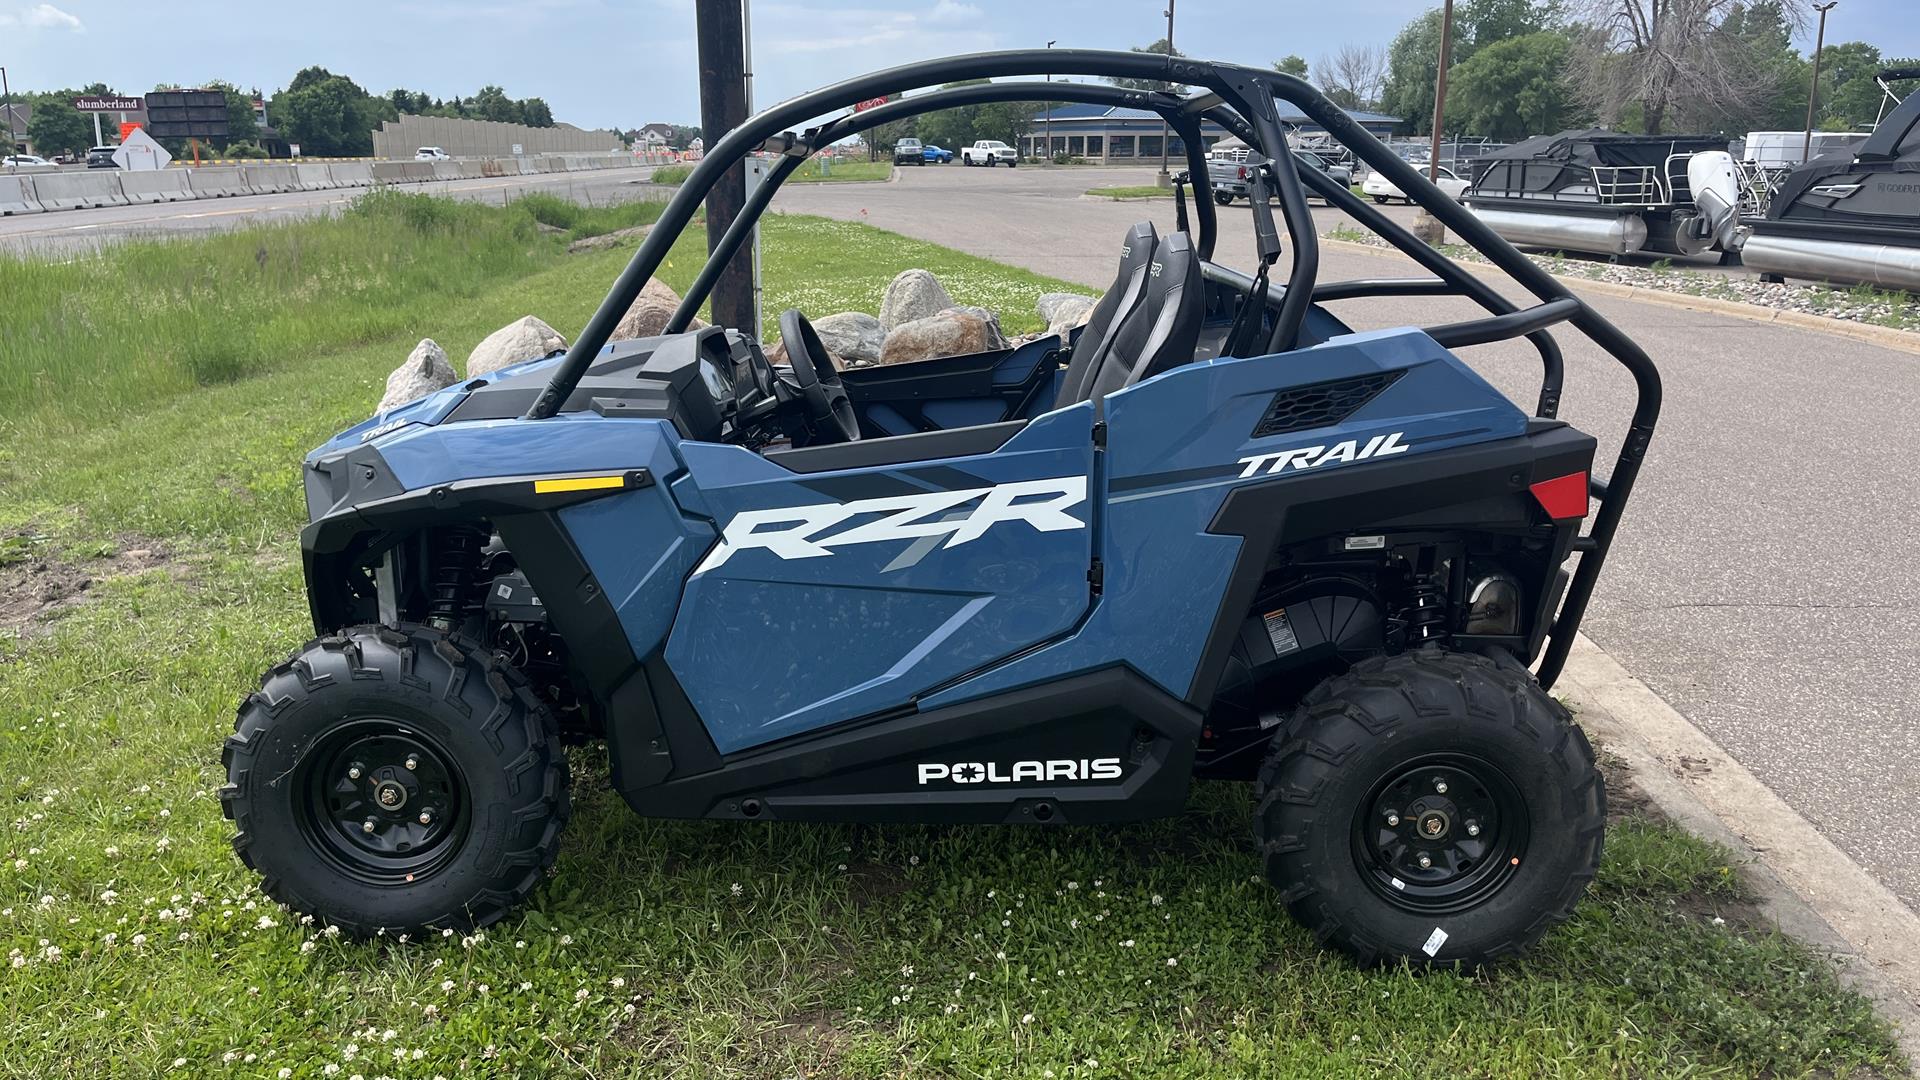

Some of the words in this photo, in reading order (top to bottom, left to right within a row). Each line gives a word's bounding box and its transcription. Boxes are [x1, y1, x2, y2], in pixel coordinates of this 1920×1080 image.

[76, 99, 138, 109] slumberland
[361, 418, 408, 442] TRAIL
[1237, 432, 1410, 479] TRAIL
[692, 475, 1087, 577] RZR
[917, 757, 1123, 785] POLARIS
